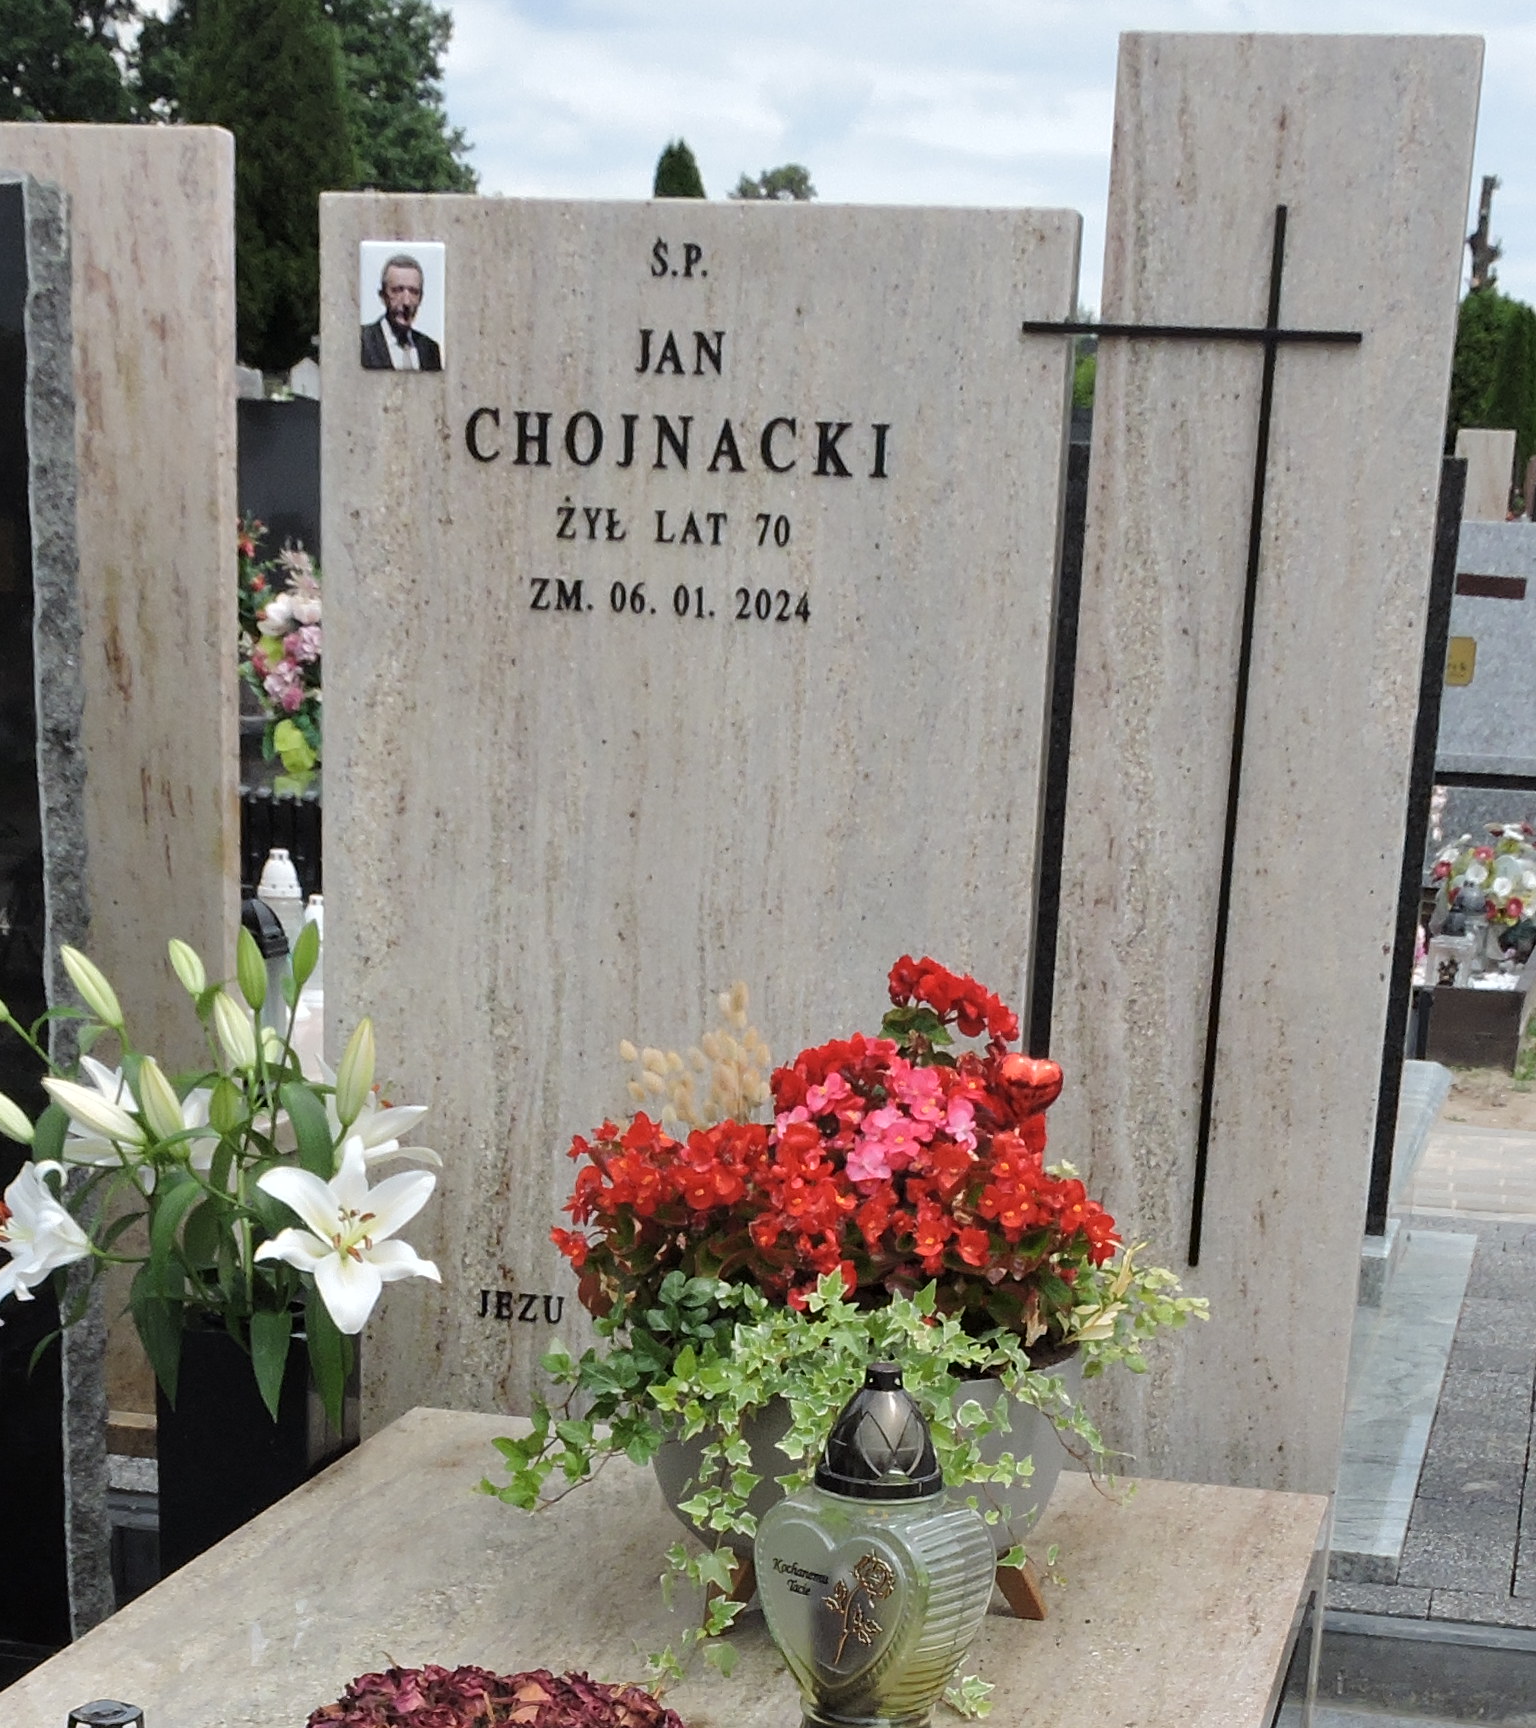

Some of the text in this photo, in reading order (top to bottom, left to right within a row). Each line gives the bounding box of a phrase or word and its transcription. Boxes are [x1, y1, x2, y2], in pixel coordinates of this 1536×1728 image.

[651, 235, 708, 278] Ś.P.
[634, 328, 726, 376] JAN
[465, 406, 890, 480] CHOJNACKI
[555, 495, 792, 547] ŻYŁ LAT 70
[529, 578, 812, 623] ZM. 06. 01. 2024
[477, 1289, 565, 1324] JEZU
